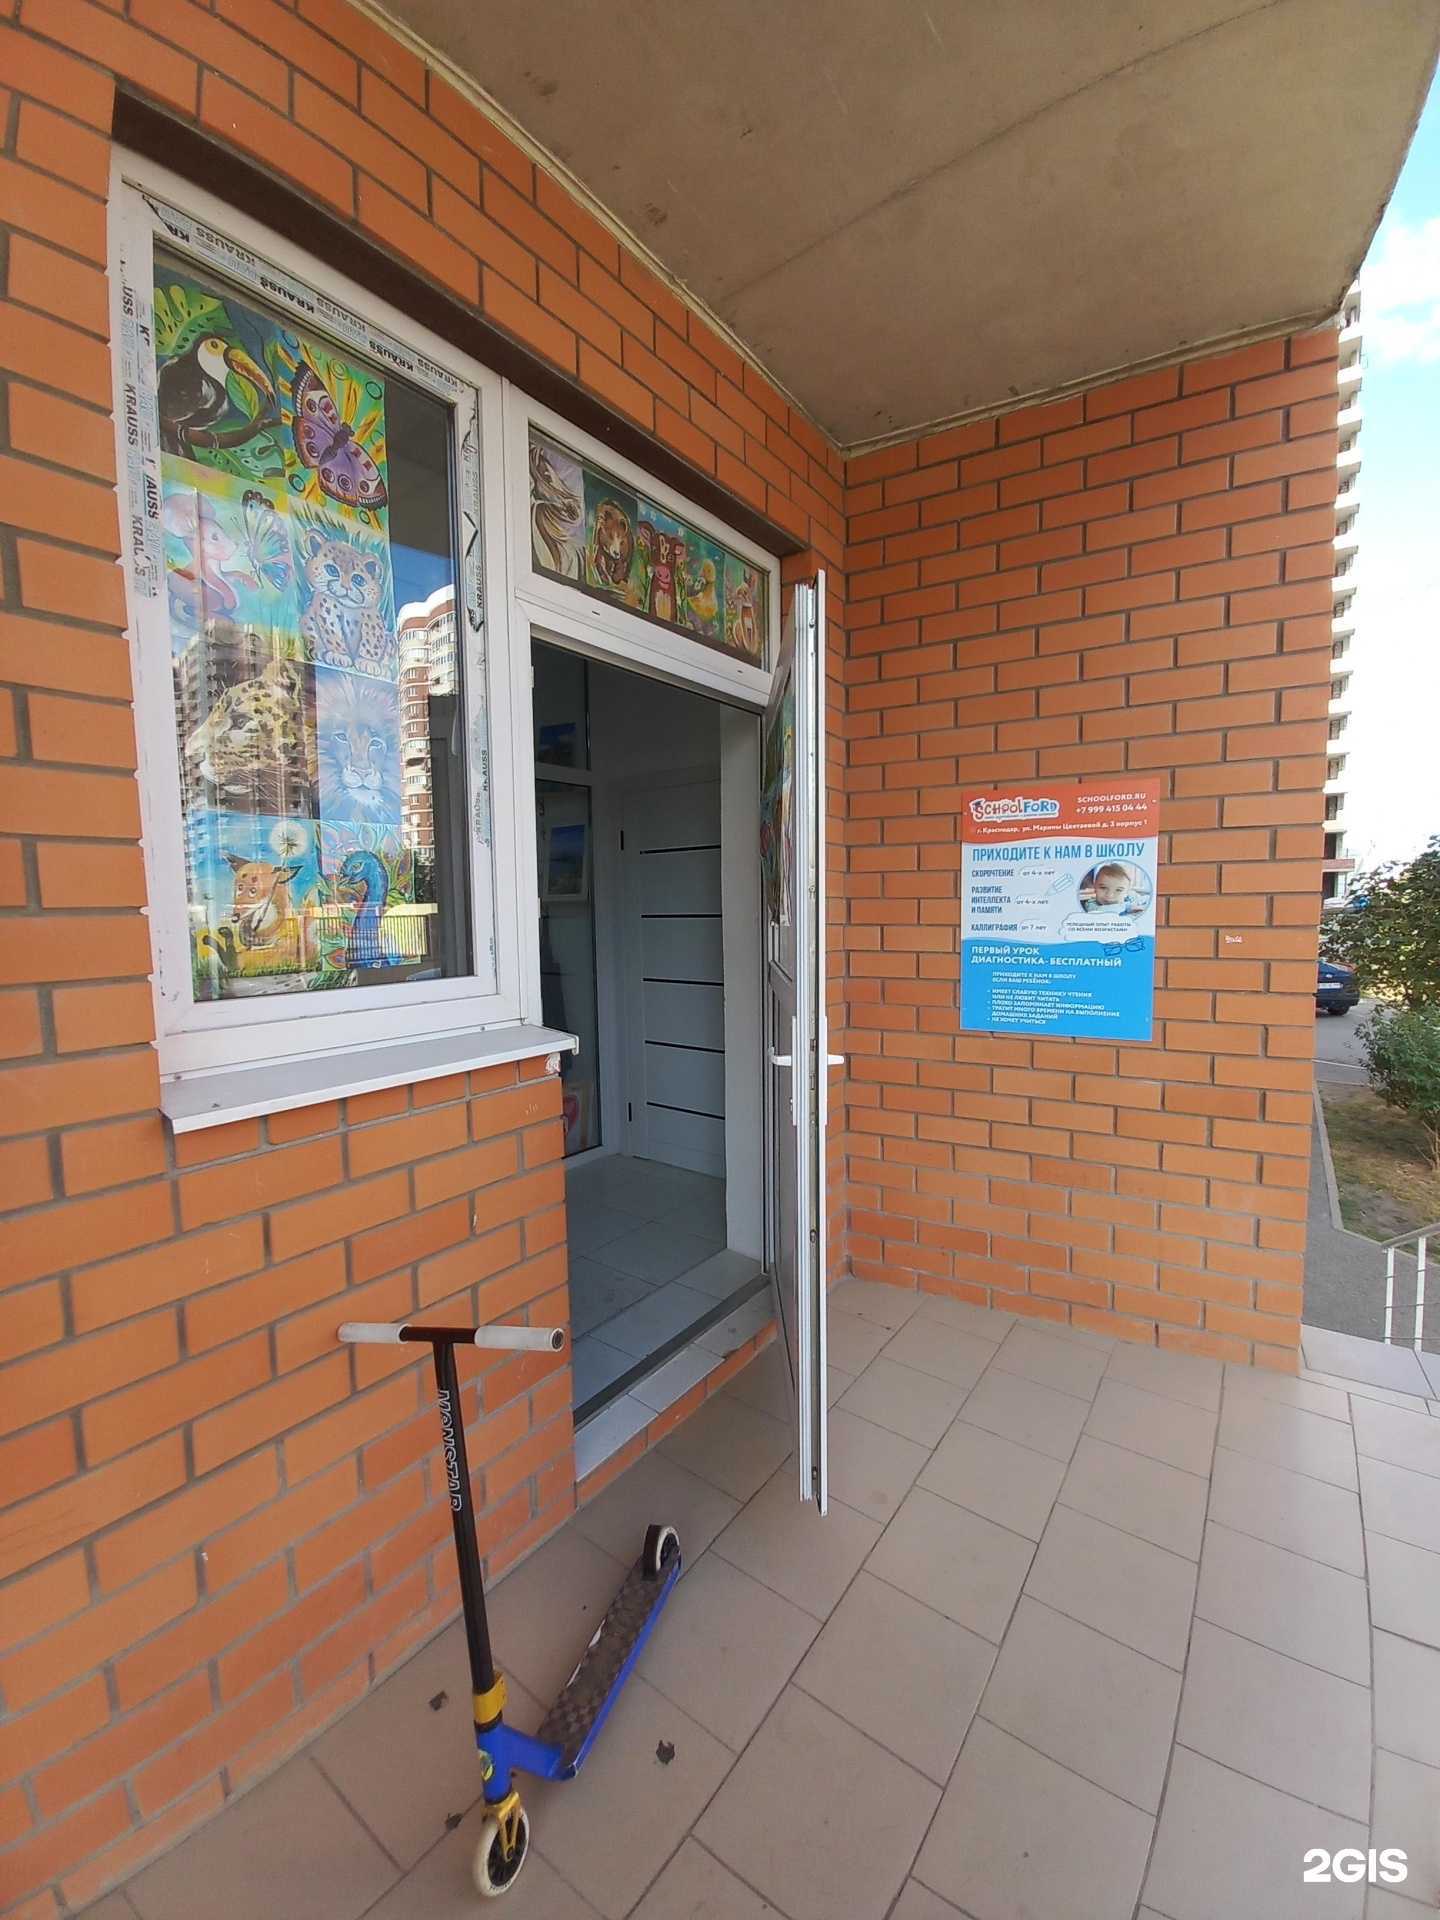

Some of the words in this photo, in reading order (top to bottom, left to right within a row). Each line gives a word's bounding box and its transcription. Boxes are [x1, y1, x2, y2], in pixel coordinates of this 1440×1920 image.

[196, 226, 256, 267] KRAUSS
[260, 276, 315, 314] KRAUSS
[316, 297, 366, 333] KRAUSS
[368, 340, 414, 372] KRAUSS
[417, 358, 458, 388] KRAUSS
[123, 383, 138, 447] KRAUSS
[1077, 793, 1146, 804] SCHOOLFORD.RU
[1076, 806, 1086, 814] +7
[1086, 805, 1104, 814] 999
[1105, 804, 1121, 813] 415
[1122, 804, 1134, 812] 04
[1134, 803, 1148, 811] 44
[973, 847, 1040, 861] ПРИХОДИТЕ
[1044, 846, 1051, 860] К
[1055, 845, 1081, 858] НАМ
[1085, 844, 1093, 858] В
[1096, 843, 1145, 857] ШКОЛУ
[972, 869, 1014, 877] СКОРОЧТЕНИЕ
[971, 886, 1002, 894] РАЗВИТИЕ
[971, 896, 1011, 904] ИНТЕЛЛЕКТА
[977, 906, 1002, 914] ПАМЯТИ
[971, 924, 1018, 932] КАЛЛИГРАФИЯ
[971, 945, 1011, 955] ПЕРВЫЙ
[1012, 947, 1040, 955] УРОК
[1050, 957, 1122, 967] БЕСПЛАТНЫЙ
